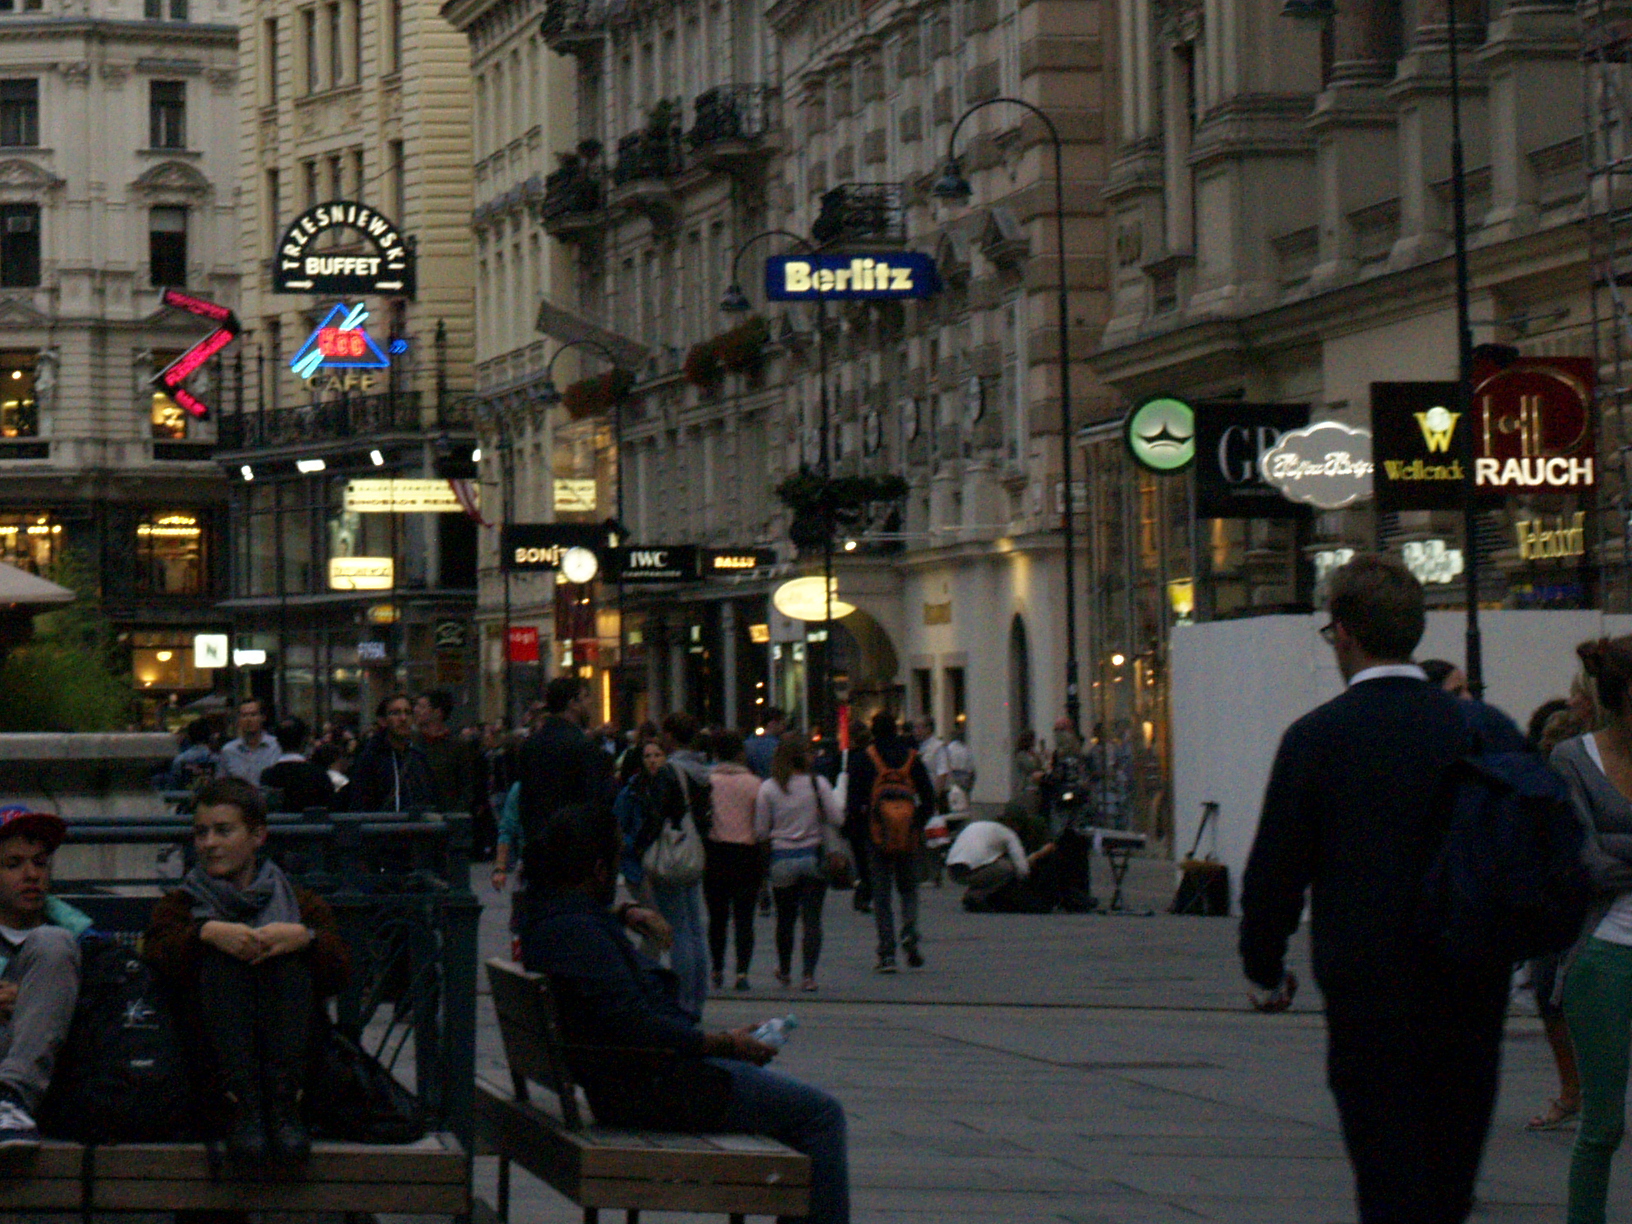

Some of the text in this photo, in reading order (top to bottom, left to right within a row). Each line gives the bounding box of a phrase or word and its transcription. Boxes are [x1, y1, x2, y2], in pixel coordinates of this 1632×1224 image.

[305, 257, 382, 276] BUFFET
[784, 257, 914, 292] Berlitz
[1474, 457, 1594, 486] RAUCH
[630, 551, 668, 568] IWC
[713, 556, 756, 568] BALLY
